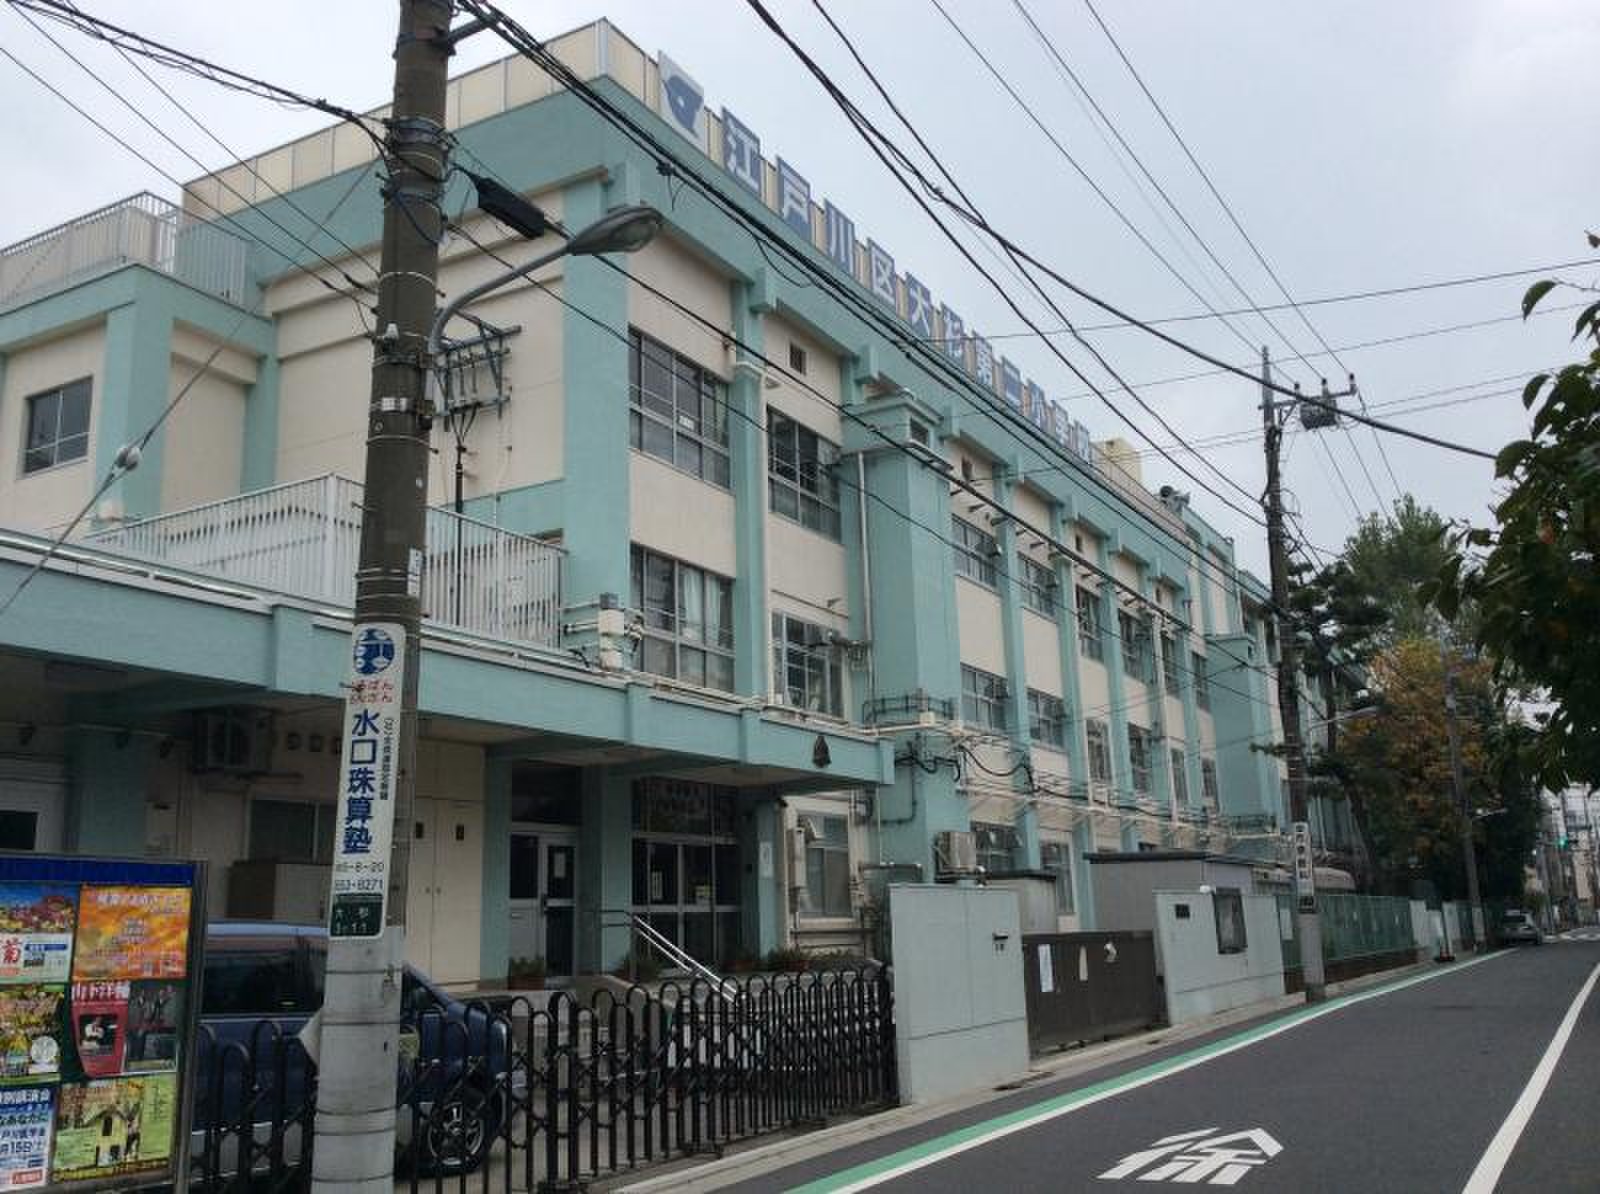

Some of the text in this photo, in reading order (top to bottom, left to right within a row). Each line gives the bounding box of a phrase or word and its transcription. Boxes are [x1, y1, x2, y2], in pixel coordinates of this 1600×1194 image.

[341, 709, 381, 855] 水口珠算塾
